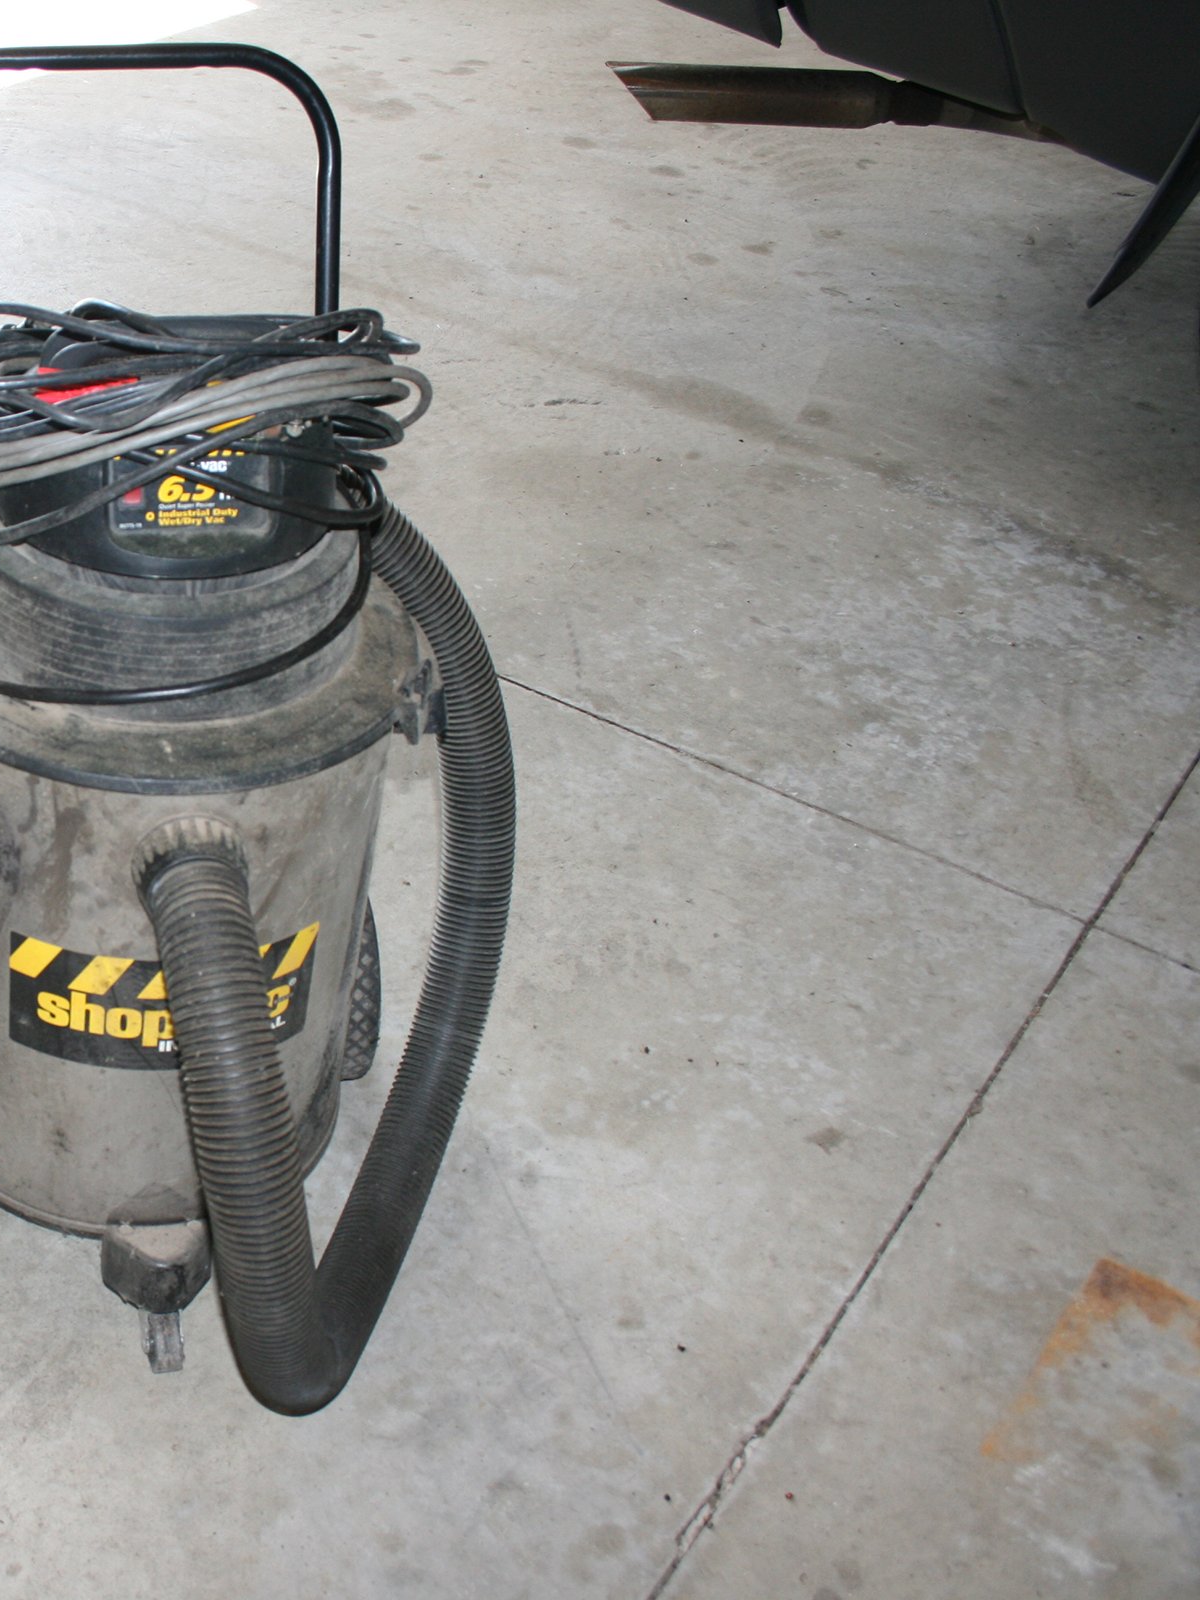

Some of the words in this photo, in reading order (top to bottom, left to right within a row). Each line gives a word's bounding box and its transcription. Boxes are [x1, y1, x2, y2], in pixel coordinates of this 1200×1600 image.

[158, 509, 211, 518] Industrial
[212, 507, 239, 518] Duty
[158, 517, 203, 527] Wet/Dry
[205, 515, 225, 524] Vac
